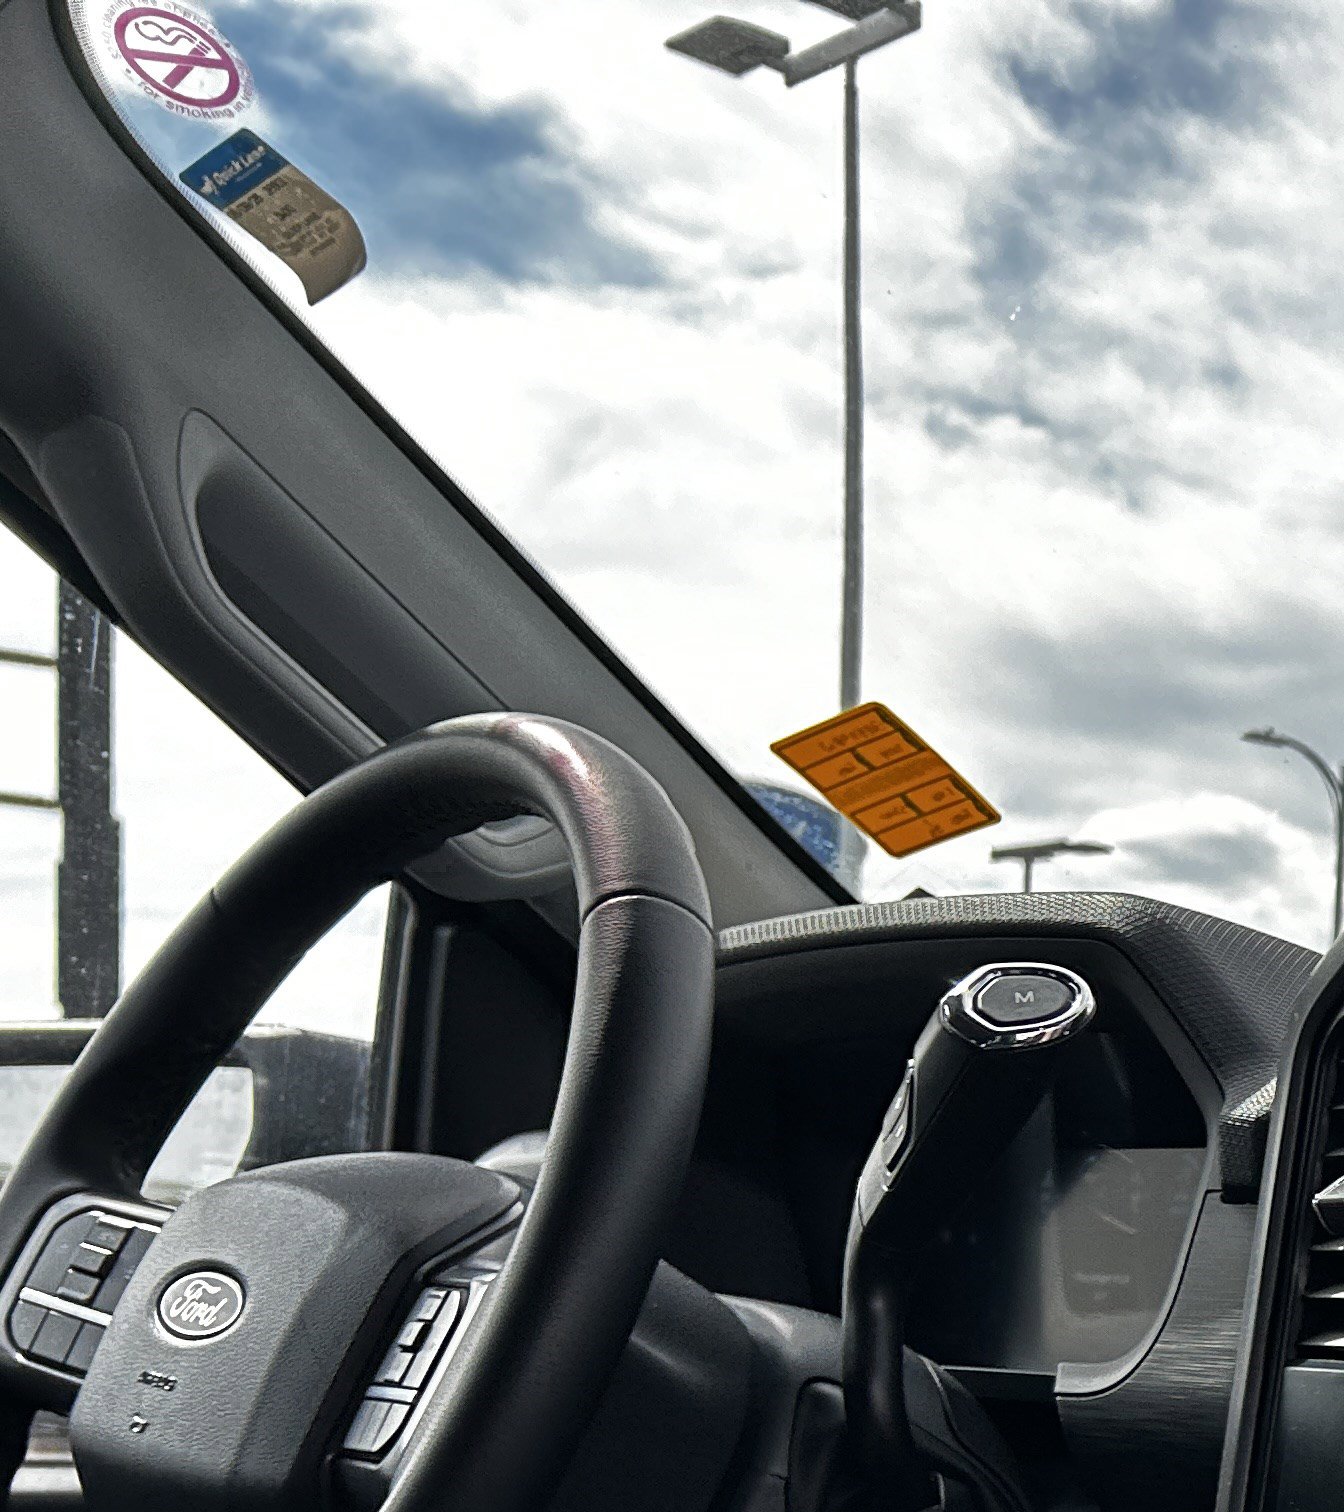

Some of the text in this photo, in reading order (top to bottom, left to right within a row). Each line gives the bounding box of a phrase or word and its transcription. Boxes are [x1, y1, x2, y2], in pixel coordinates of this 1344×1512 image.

[165, 100, 235, 119] smoking
[232, 101, 246, 112] in
[1014, 990, 1035, 1004] M
[170, 1280, 228, 1326] Ford
